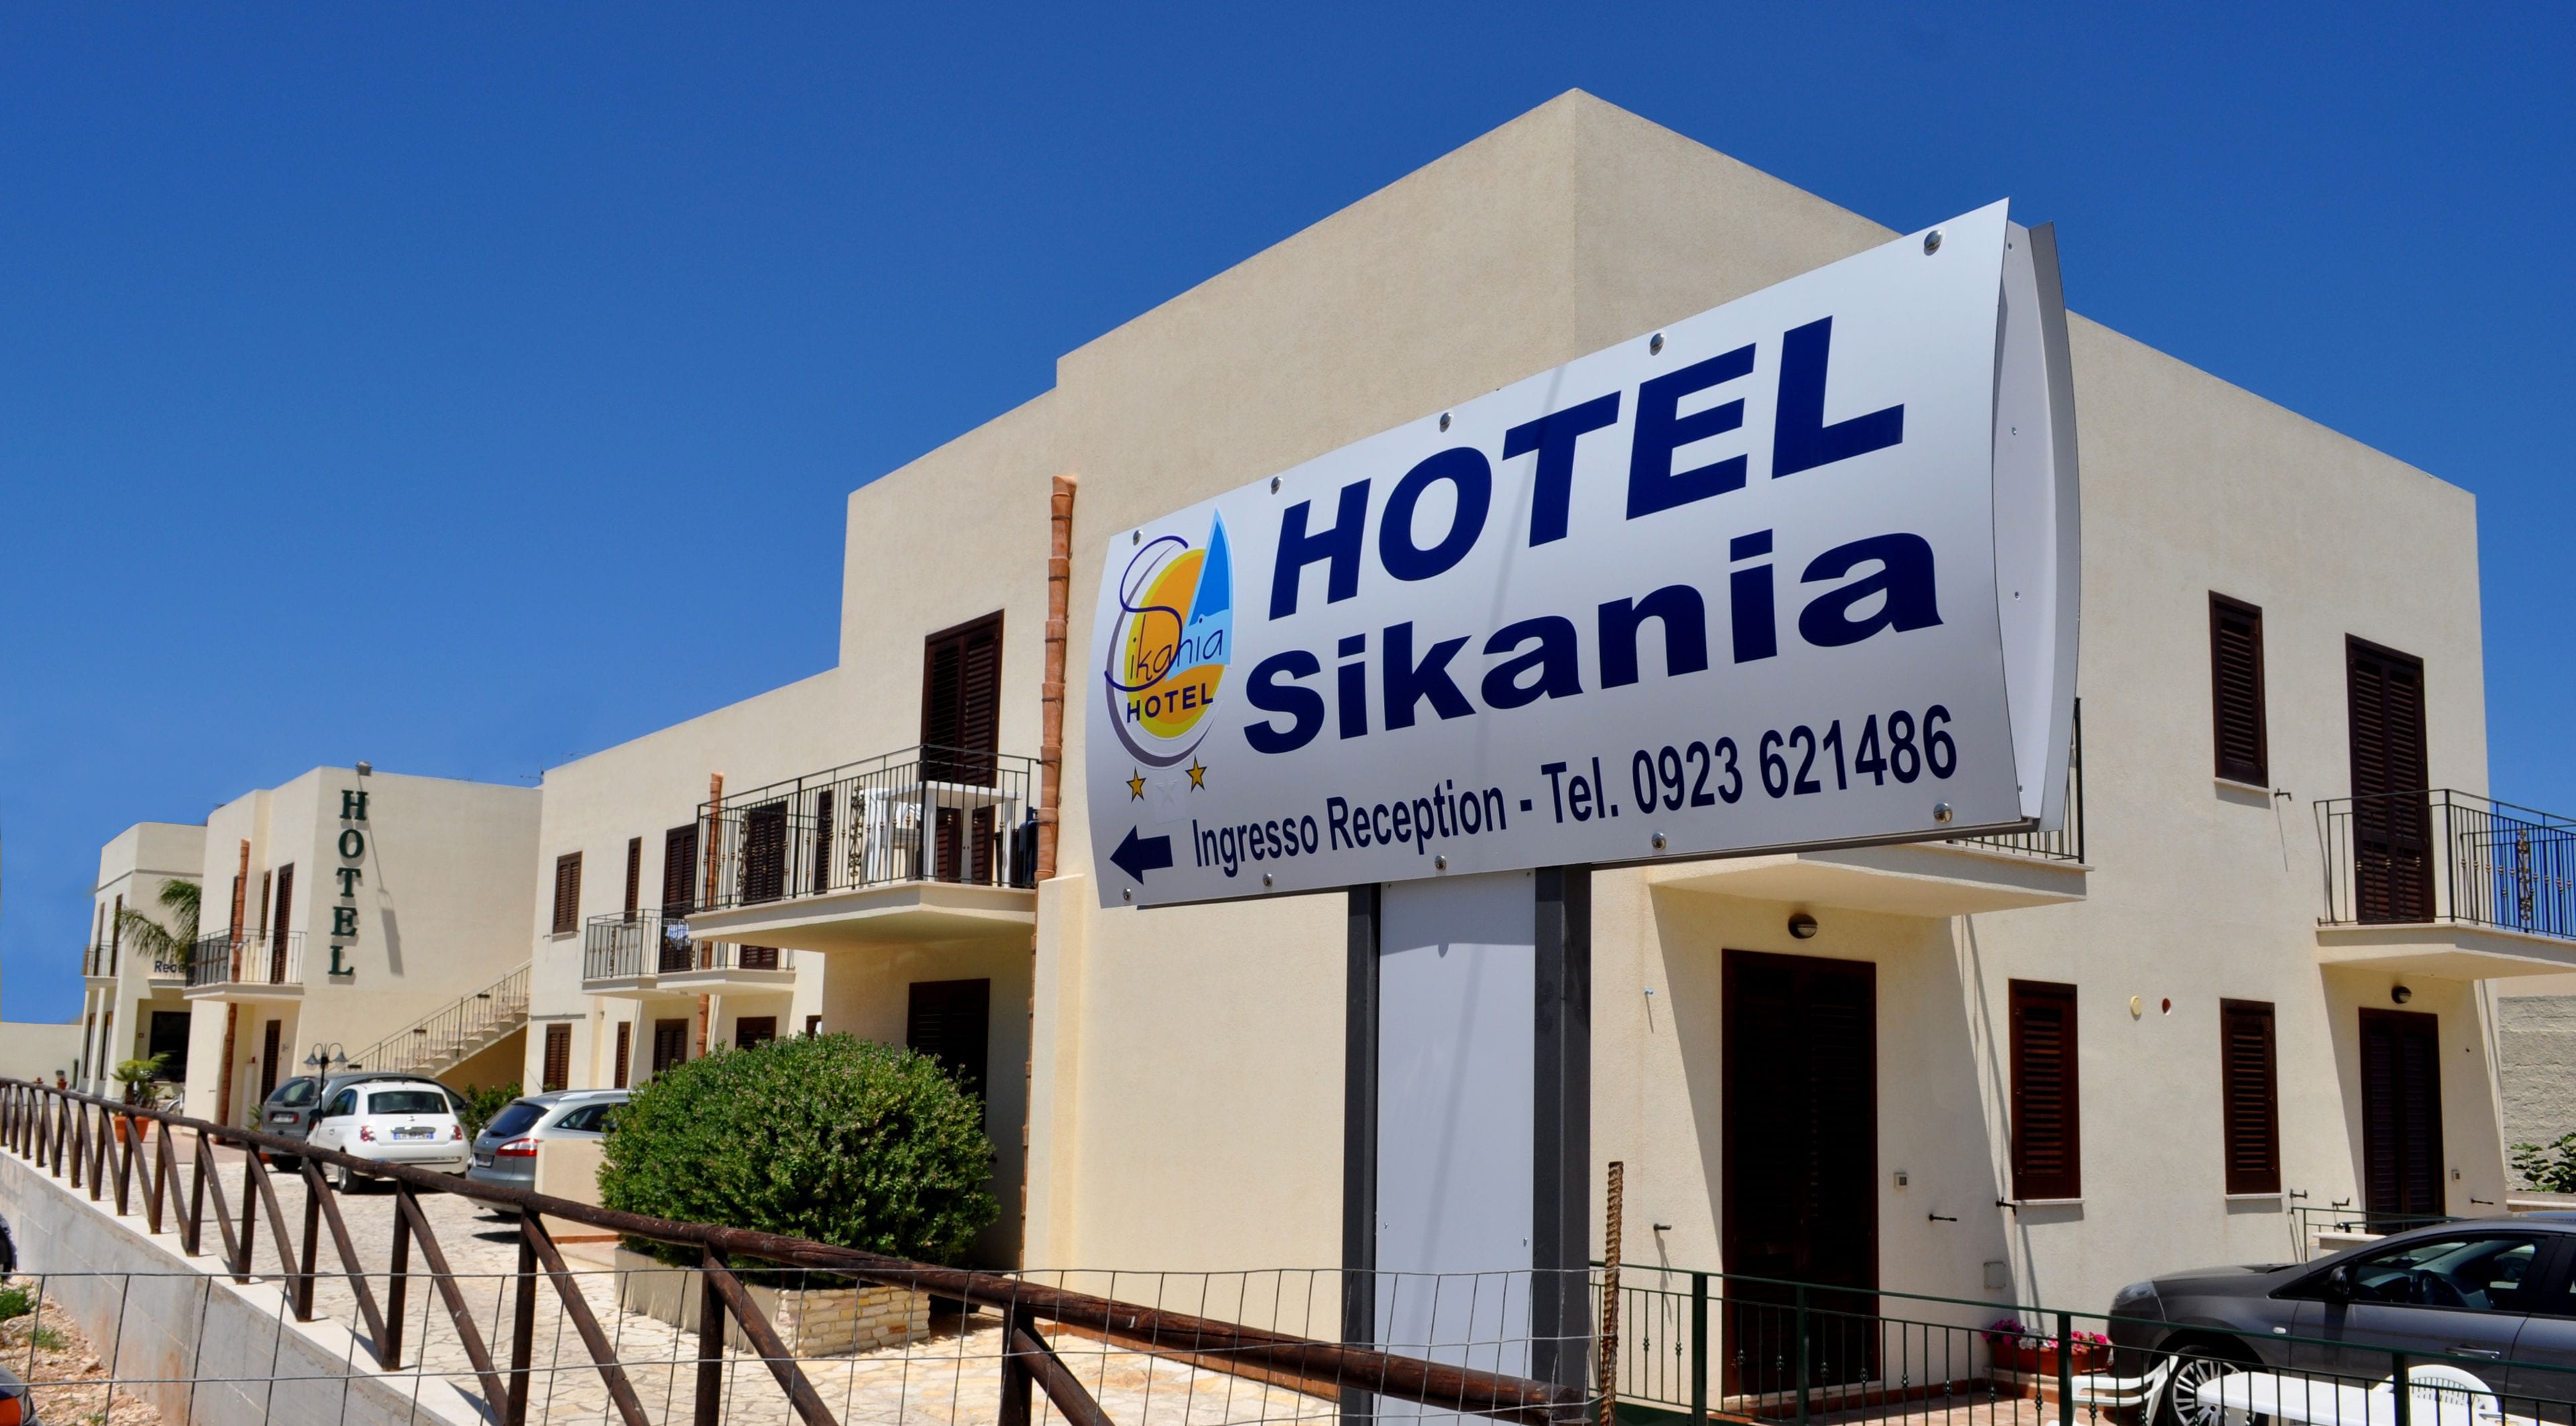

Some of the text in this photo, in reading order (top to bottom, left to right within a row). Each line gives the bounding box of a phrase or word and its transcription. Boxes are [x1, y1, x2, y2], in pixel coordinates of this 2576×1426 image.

[1269, 315, 1904, 621] HOTEL
[1104, 535, 1224, 692] Sikania
[1126, 683, 1214, 724] HOTEL
[1244, 529, 1943, 754] Sikania
[1192, 815, 1319, 878] Ingresso
[1326, 779, 1507, 855] Reception
[1541, 757, 1619, 824] Tel.
[1632, 736, 1743, 814] 0923
[1759, 704, 1957, 800] 621486
[328, 789, 368, 976] HOTEL
